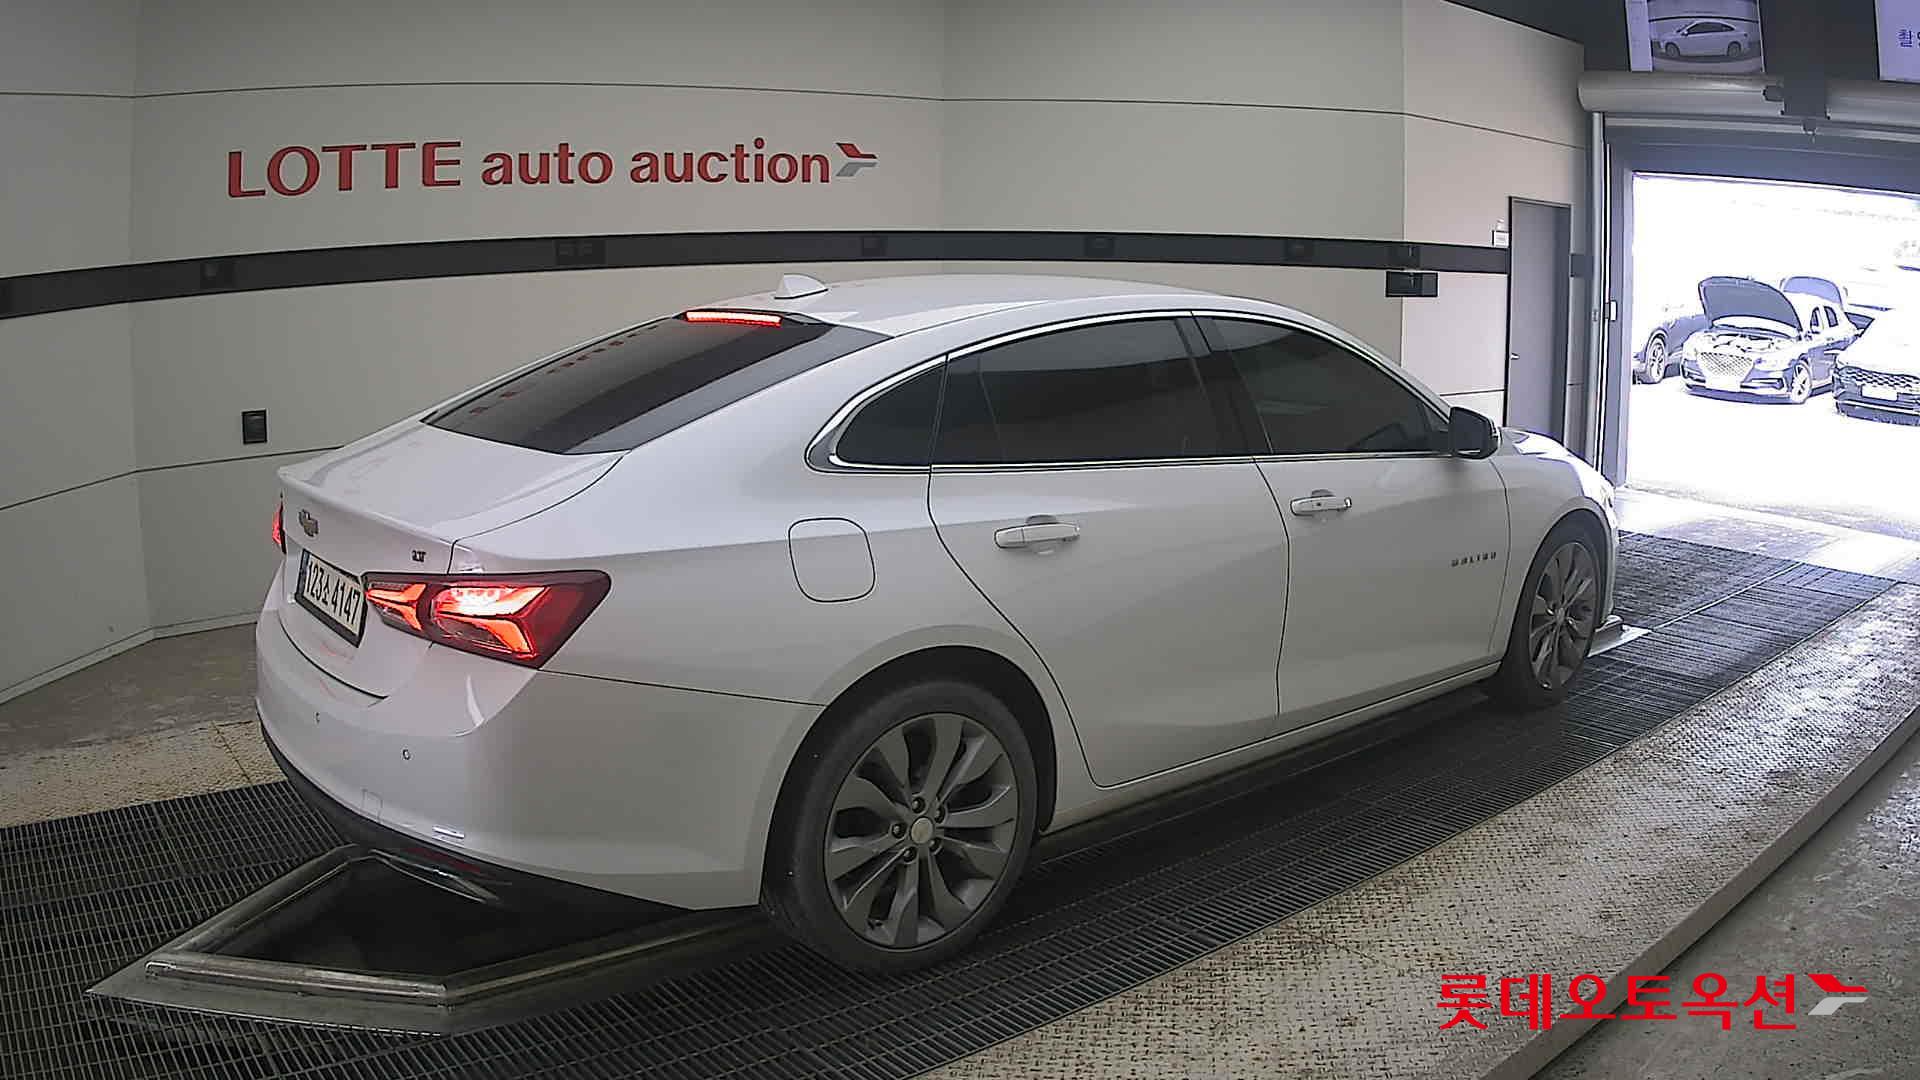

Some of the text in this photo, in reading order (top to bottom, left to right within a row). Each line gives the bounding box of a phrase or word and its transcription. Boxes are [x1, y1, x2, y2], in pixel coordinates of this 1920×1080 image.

[228, 138, 830, 198] LOTTE auto auction
